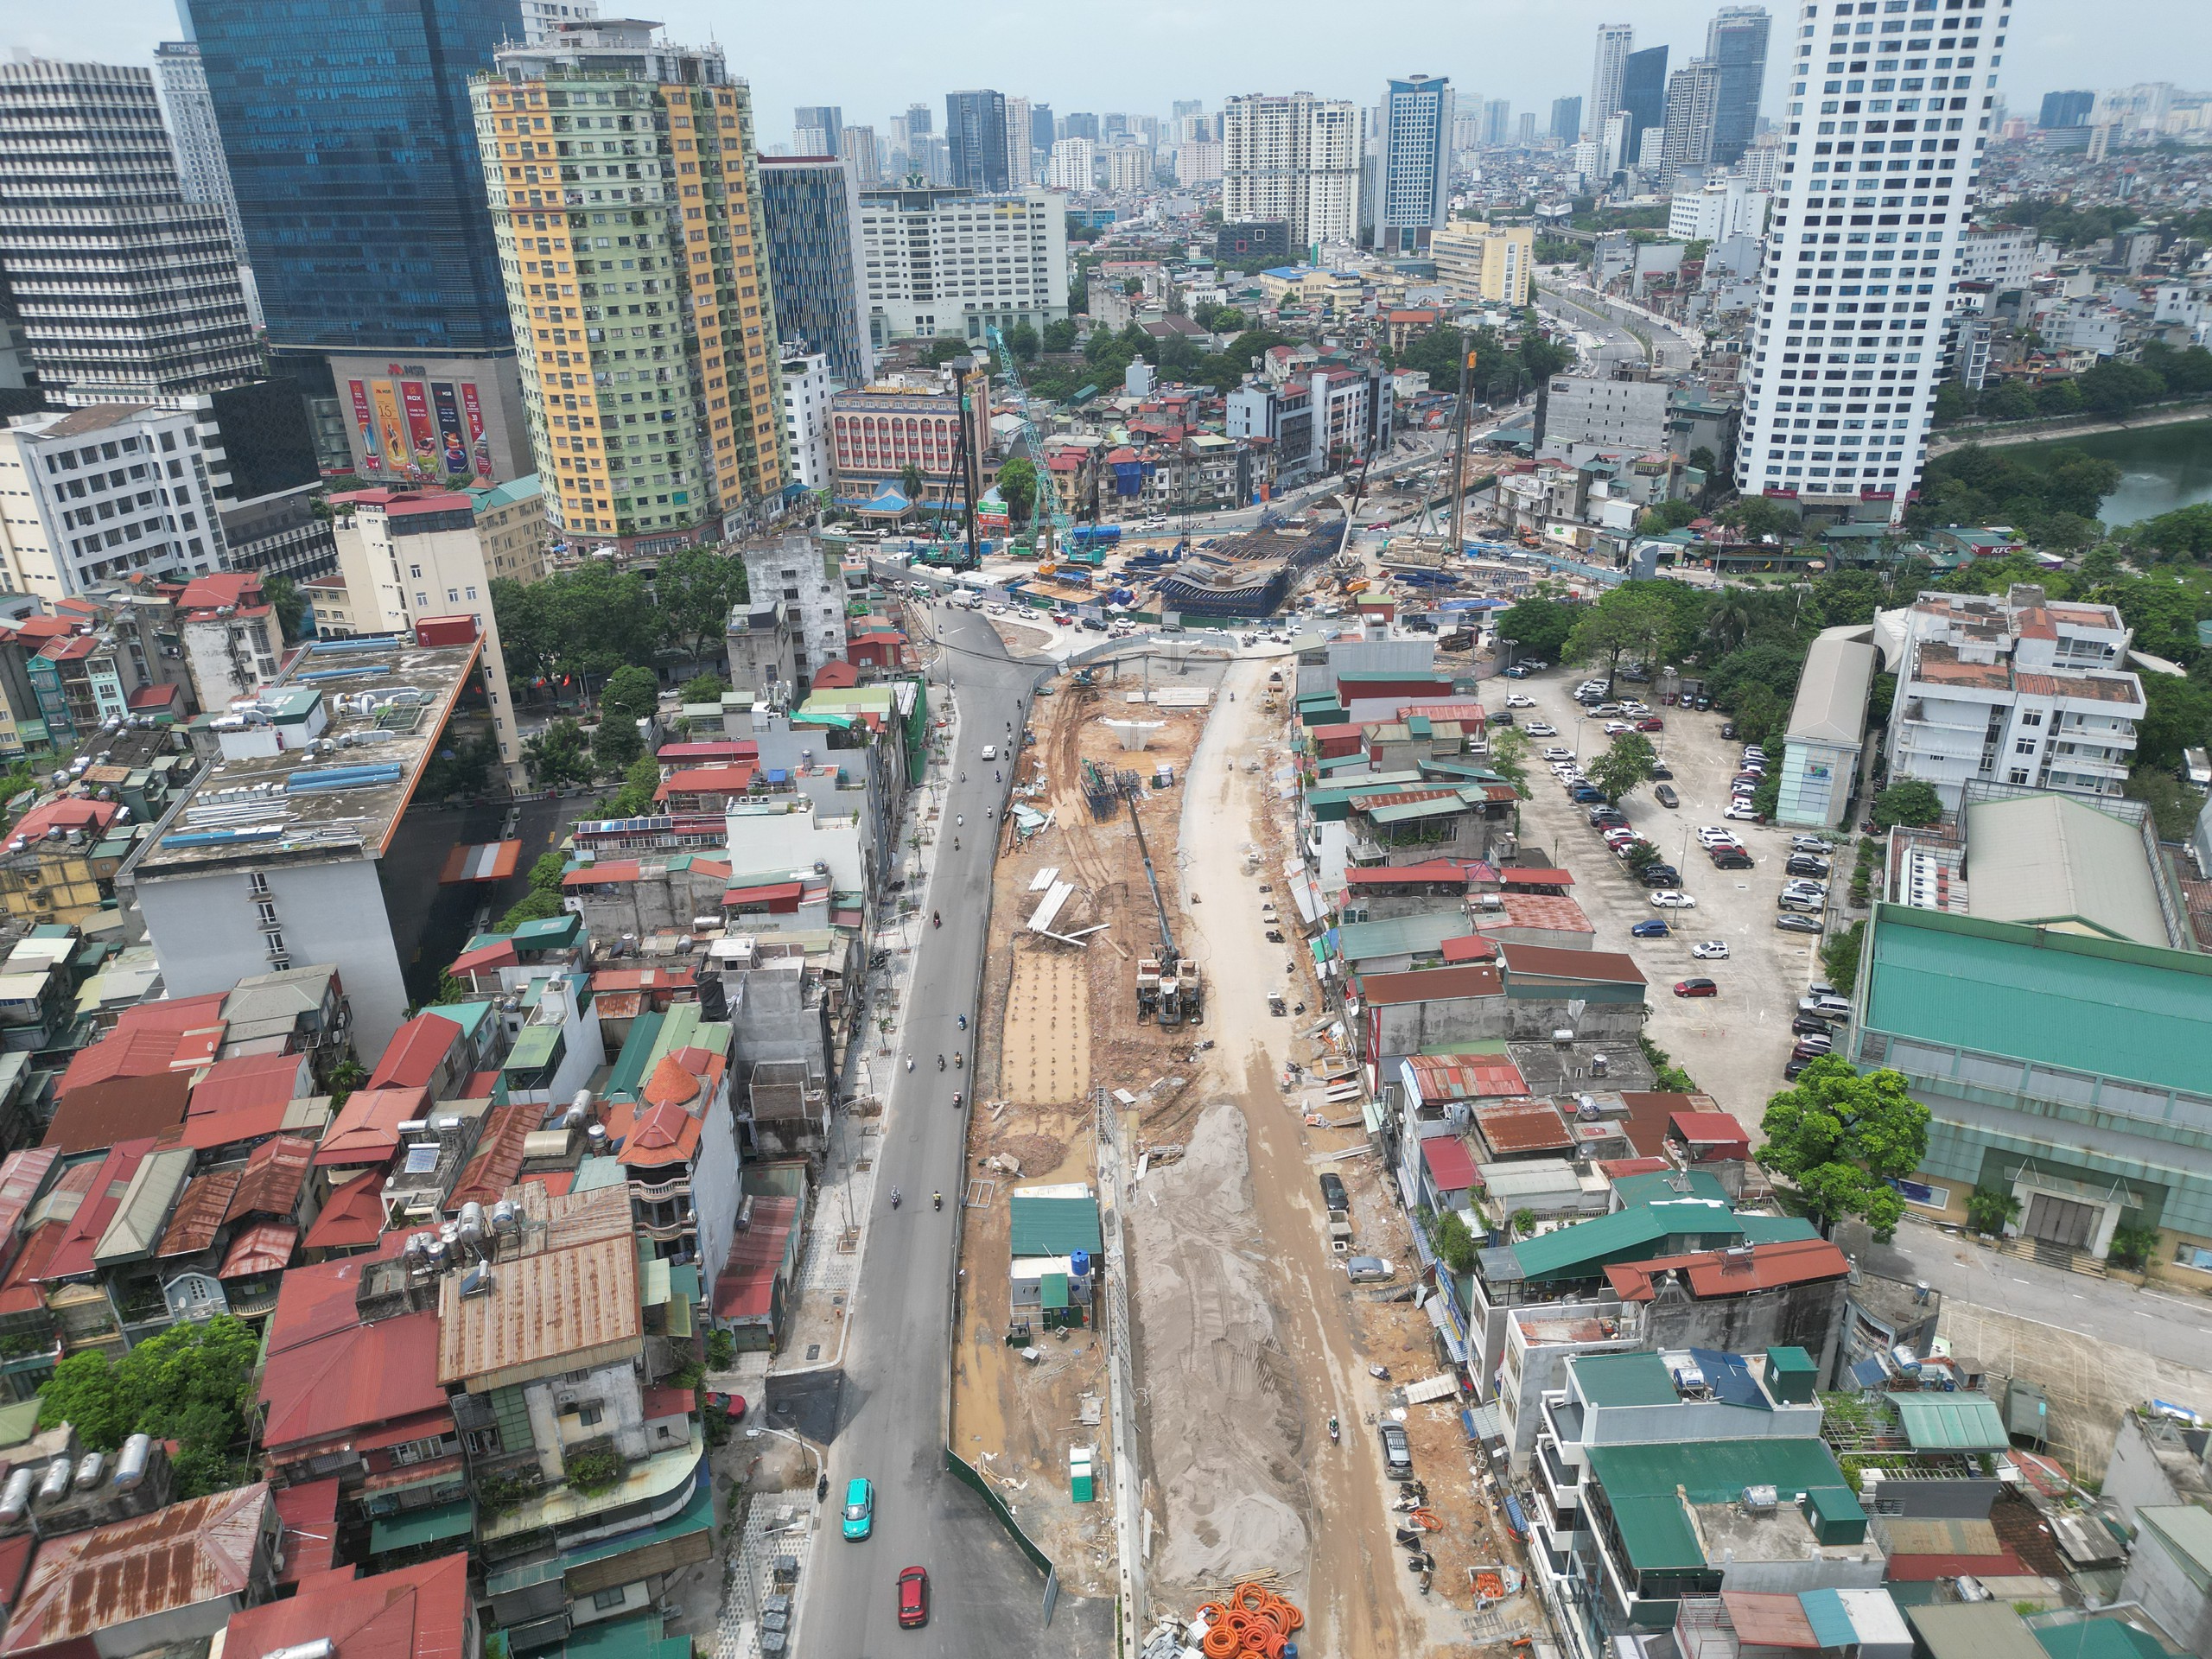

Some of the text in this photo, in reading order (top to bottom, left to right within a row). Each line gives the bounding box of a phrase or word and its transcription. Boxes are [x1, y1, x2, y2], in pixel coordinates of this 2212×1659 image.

[404, 365, 426, 376] MSB
[378, 404, 392, 417] 15
[414, 474, 437, 482] ROX
[1971, 543, 1980, 553] KFC
